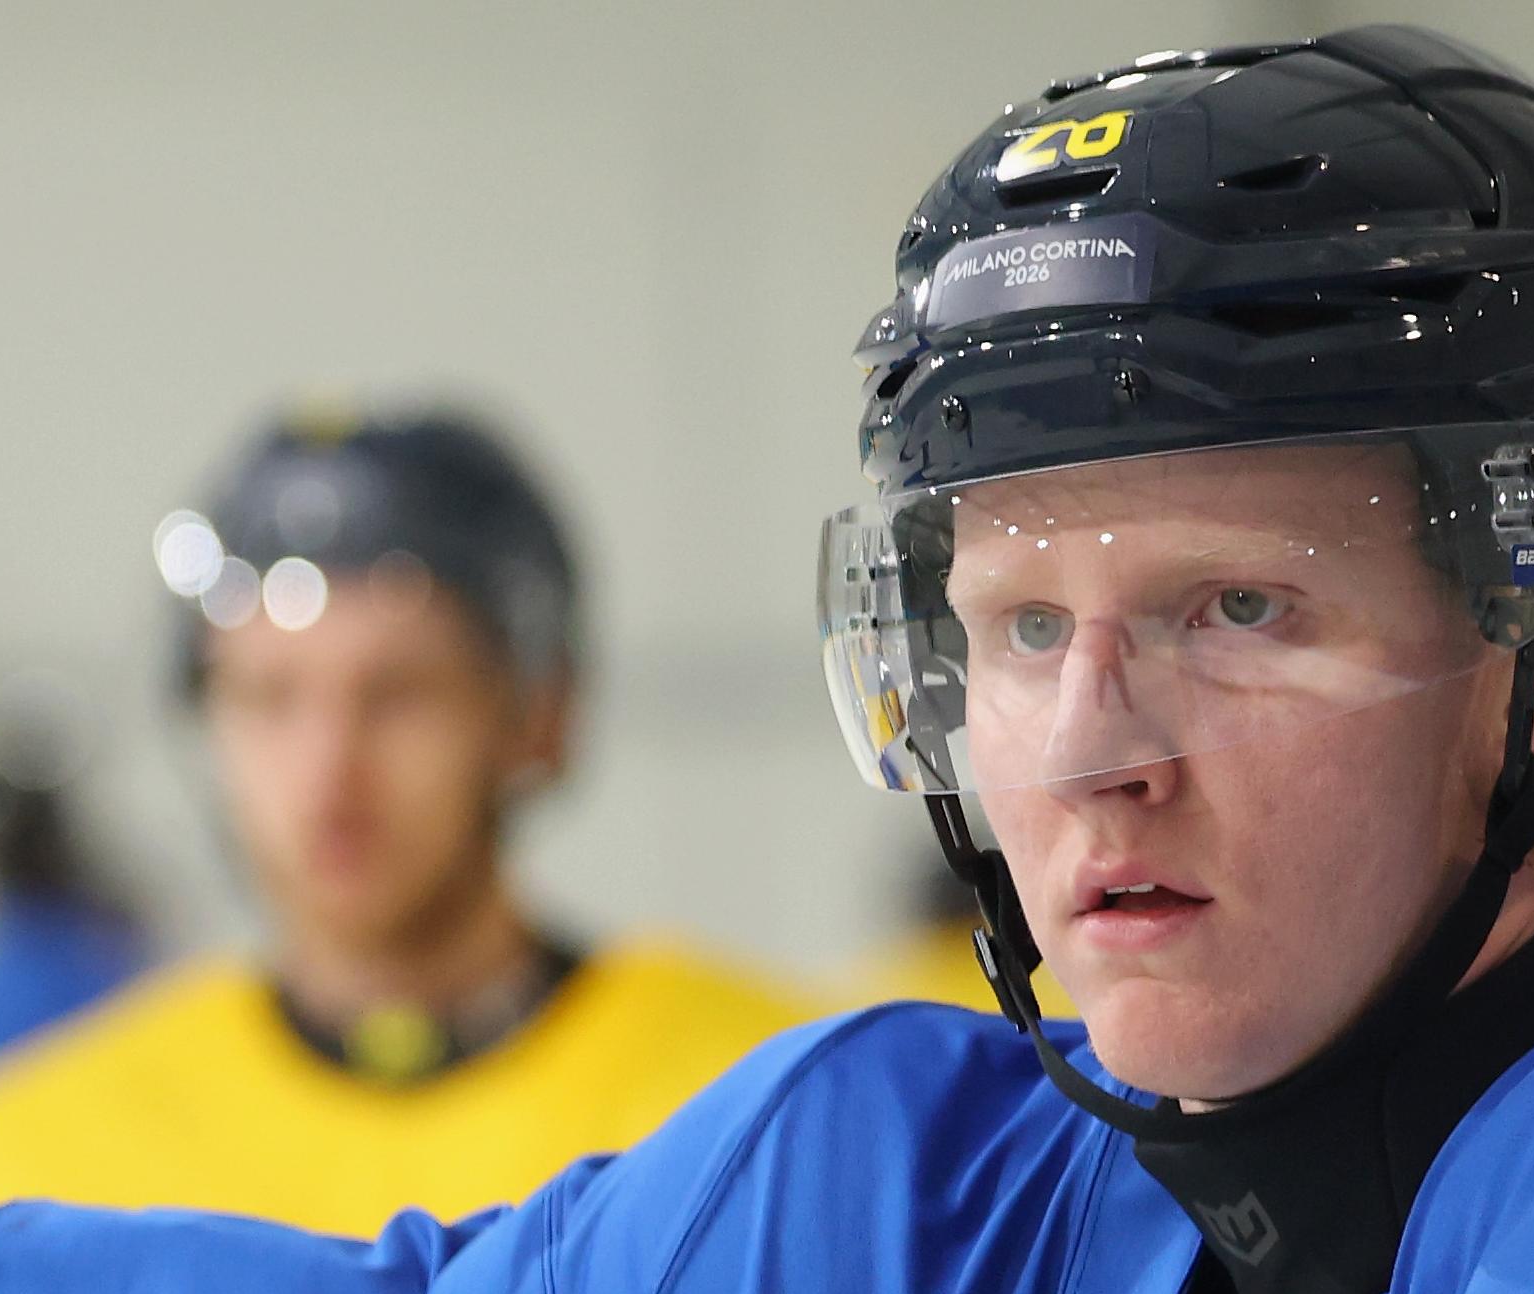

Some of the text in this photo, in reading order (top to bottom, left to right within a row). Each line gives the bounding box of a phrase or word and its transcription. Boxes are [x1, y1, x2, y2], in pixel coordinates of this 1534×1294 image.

[944, 238, 1136, 286] MILANO CORTINA
[1004, 263, 1050, 287] 2026
